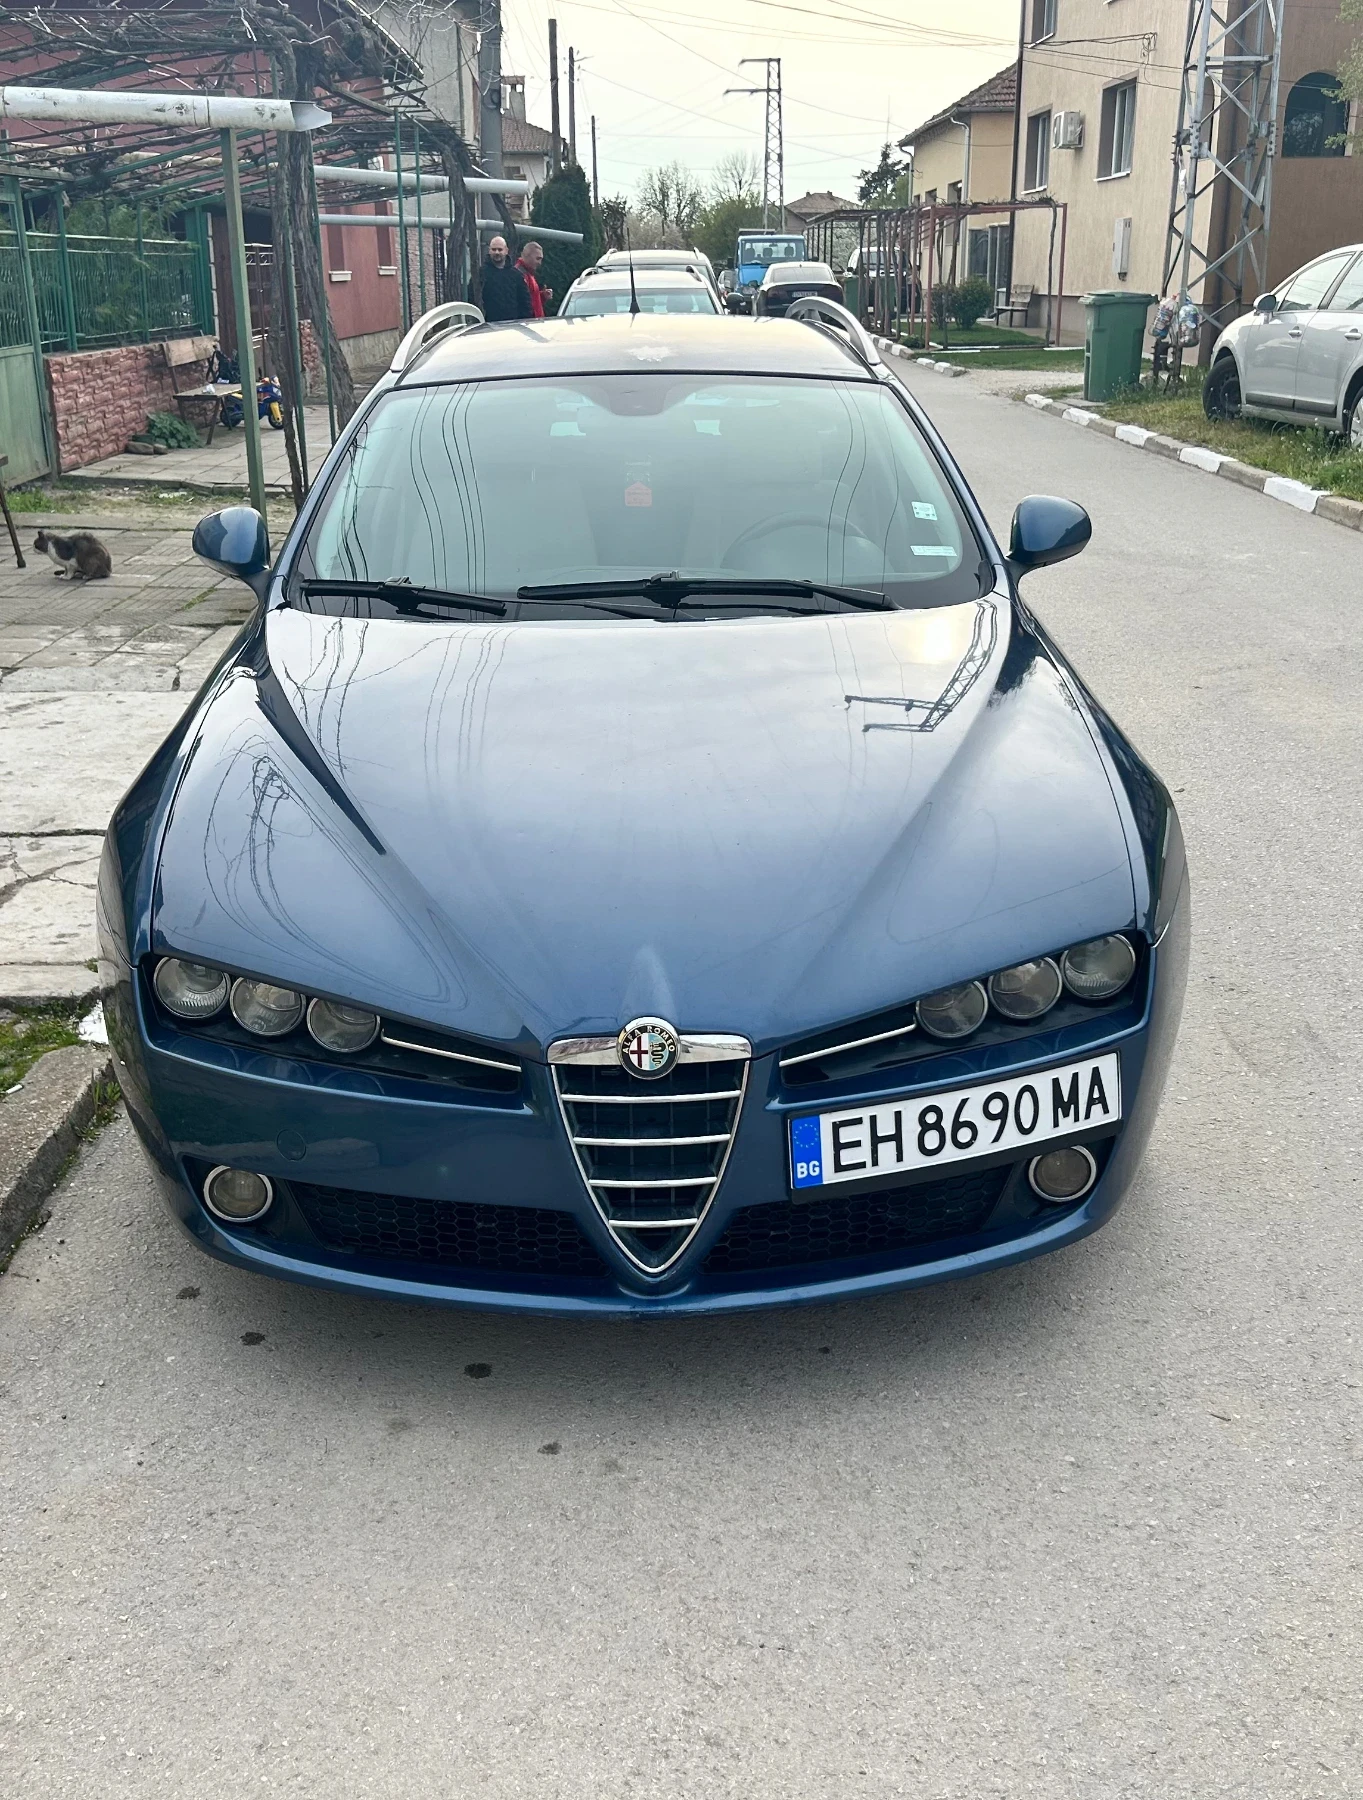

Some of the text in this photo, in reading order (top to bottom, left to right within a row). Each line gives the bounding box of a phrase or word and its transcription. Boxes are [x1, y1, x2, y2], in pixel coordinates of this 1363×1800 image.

[622, 1025, 676, 1054] ALFA ROMEO
[831, 1066, 1110, 1174] EH 8690 MA
[796, 1162, 820, 1179] BG
